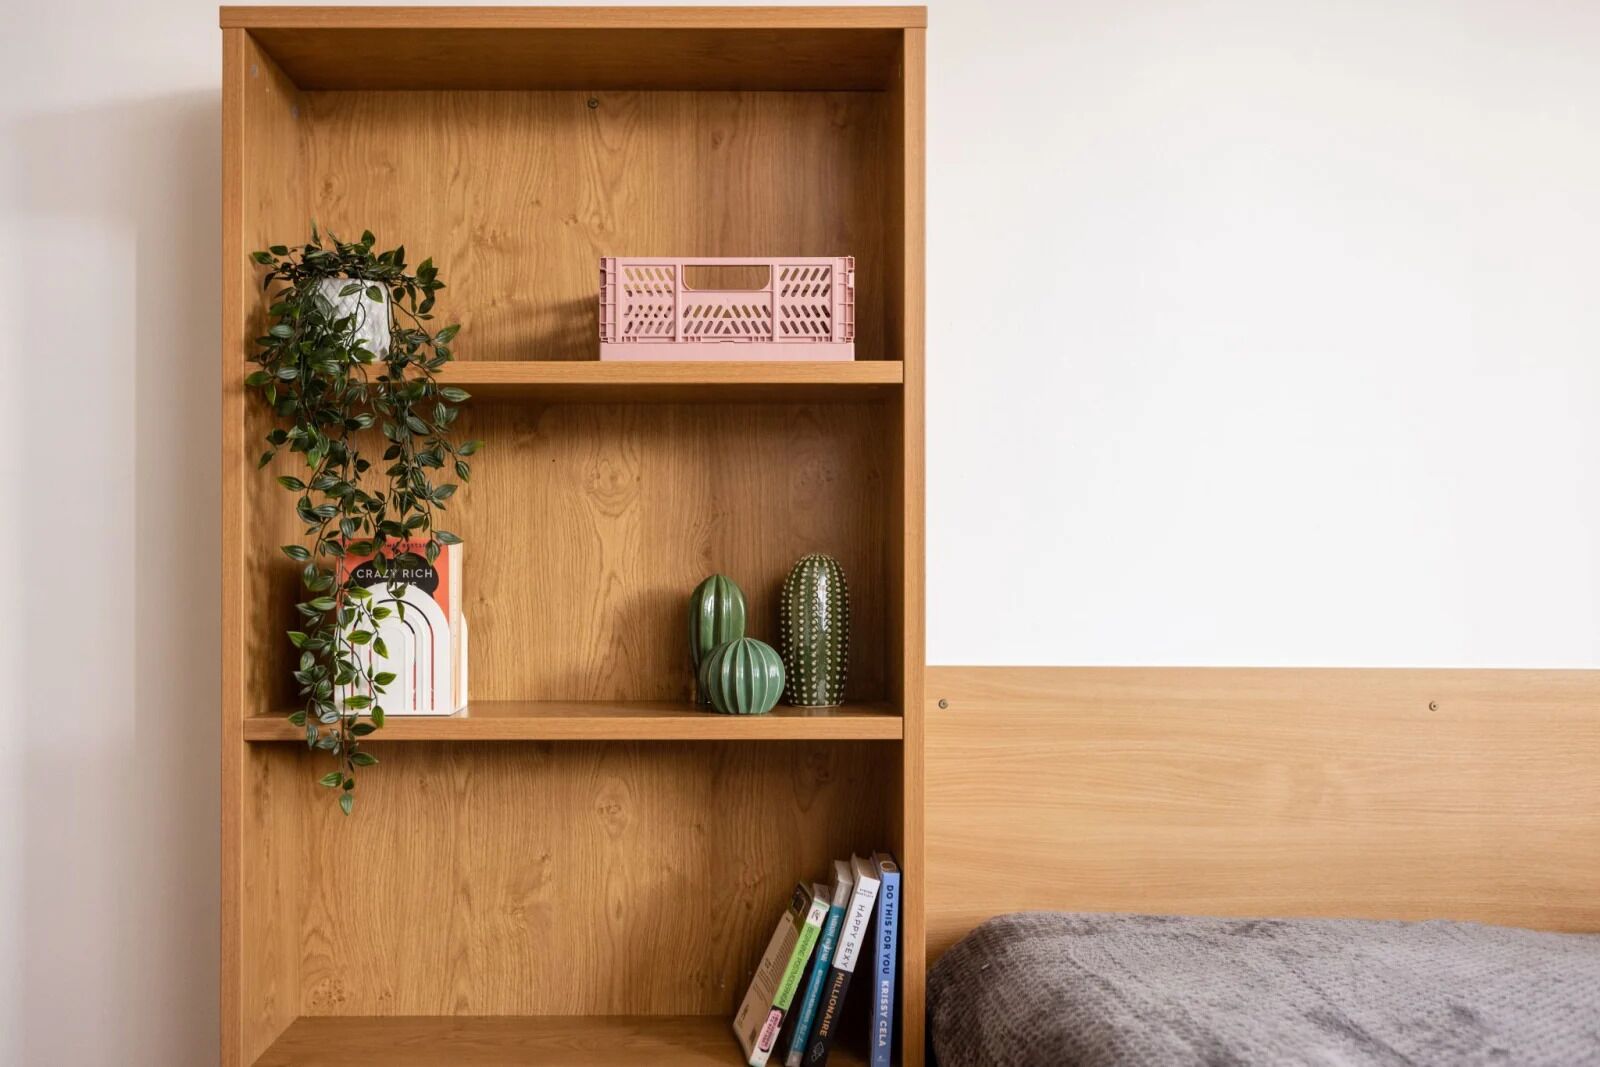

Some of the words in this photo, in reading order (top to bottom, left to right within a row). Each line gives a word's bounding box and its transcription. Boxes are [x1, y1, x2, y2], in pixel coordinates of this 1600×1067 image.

[356, 569, 397, 578] CRAZY
[402, 569, 433, 578] RICH
[886, 885, 894, 899] DO
[850, 905, 865, 939] HAPPY
[885, 902, 893, 926] THIS
[884, 929, 892, 949] FOR
[842, 942, 854, 968] SEXY
[882, 951, 891, 974] YOU
[820, 972, 845, 1037] MILLIONAIRE
[880, 980, 889, 1017] KRISSY
[879, 1019, 888, 1047] CELA
